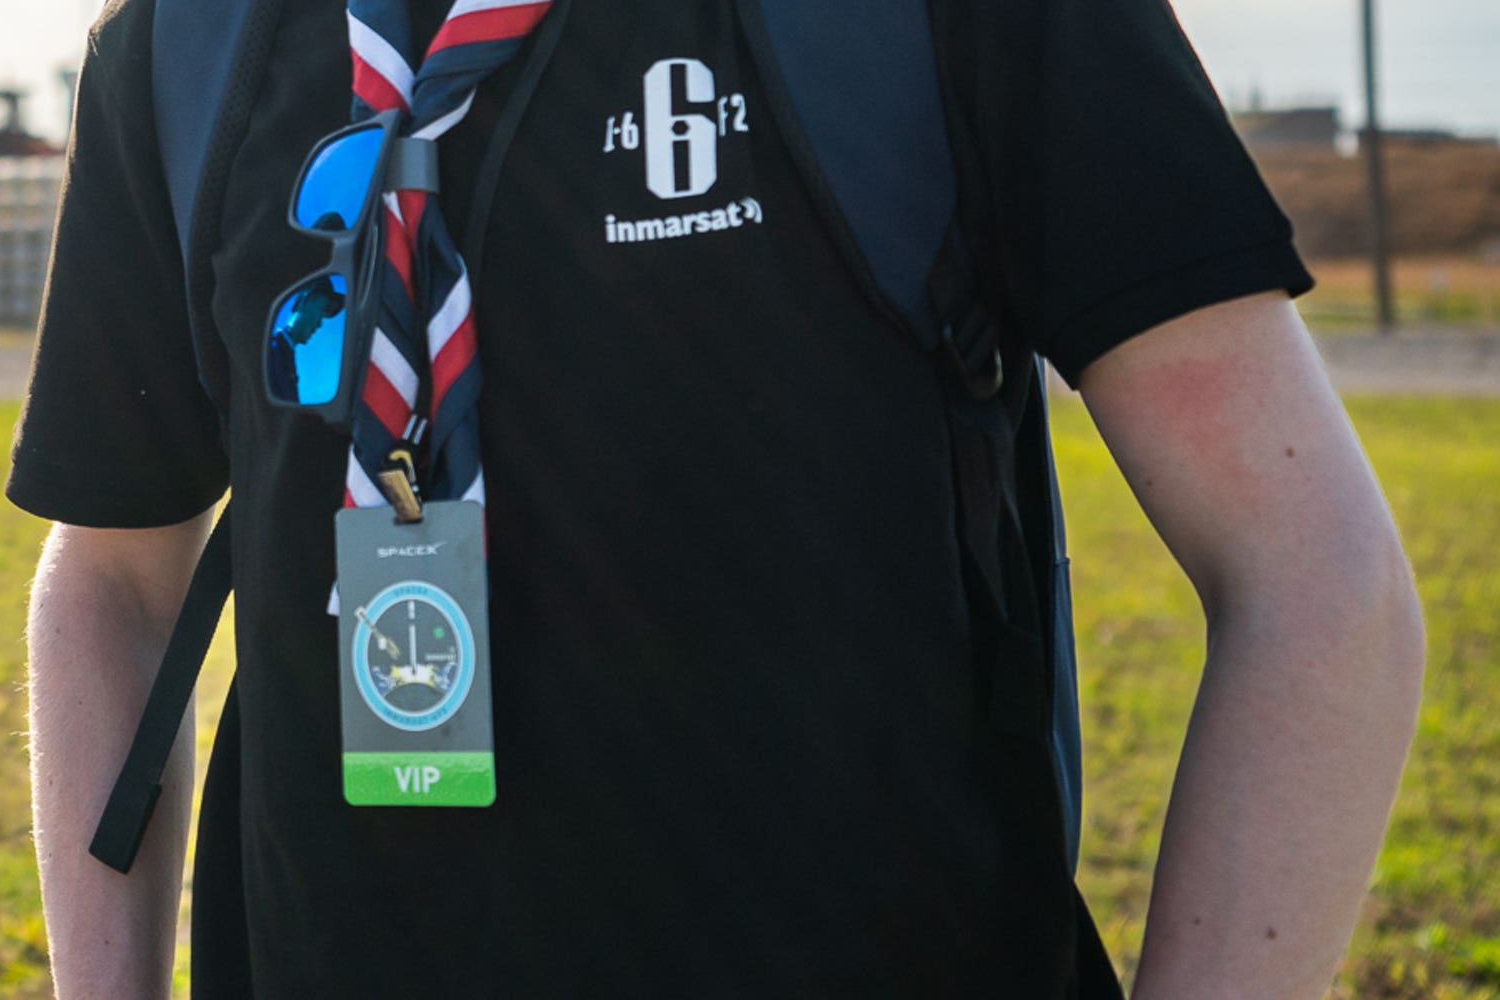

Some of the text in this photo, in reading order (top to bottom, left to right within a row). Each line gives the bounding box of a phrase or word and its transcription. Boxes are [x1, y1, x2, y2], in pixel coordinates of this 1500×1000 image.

[717, 93, 750, 137] F2
[605, 201, 743, 243] inmarsat
[377, 542, 447, 558] SPACEX
[394, 766, 441, 793] VIP
